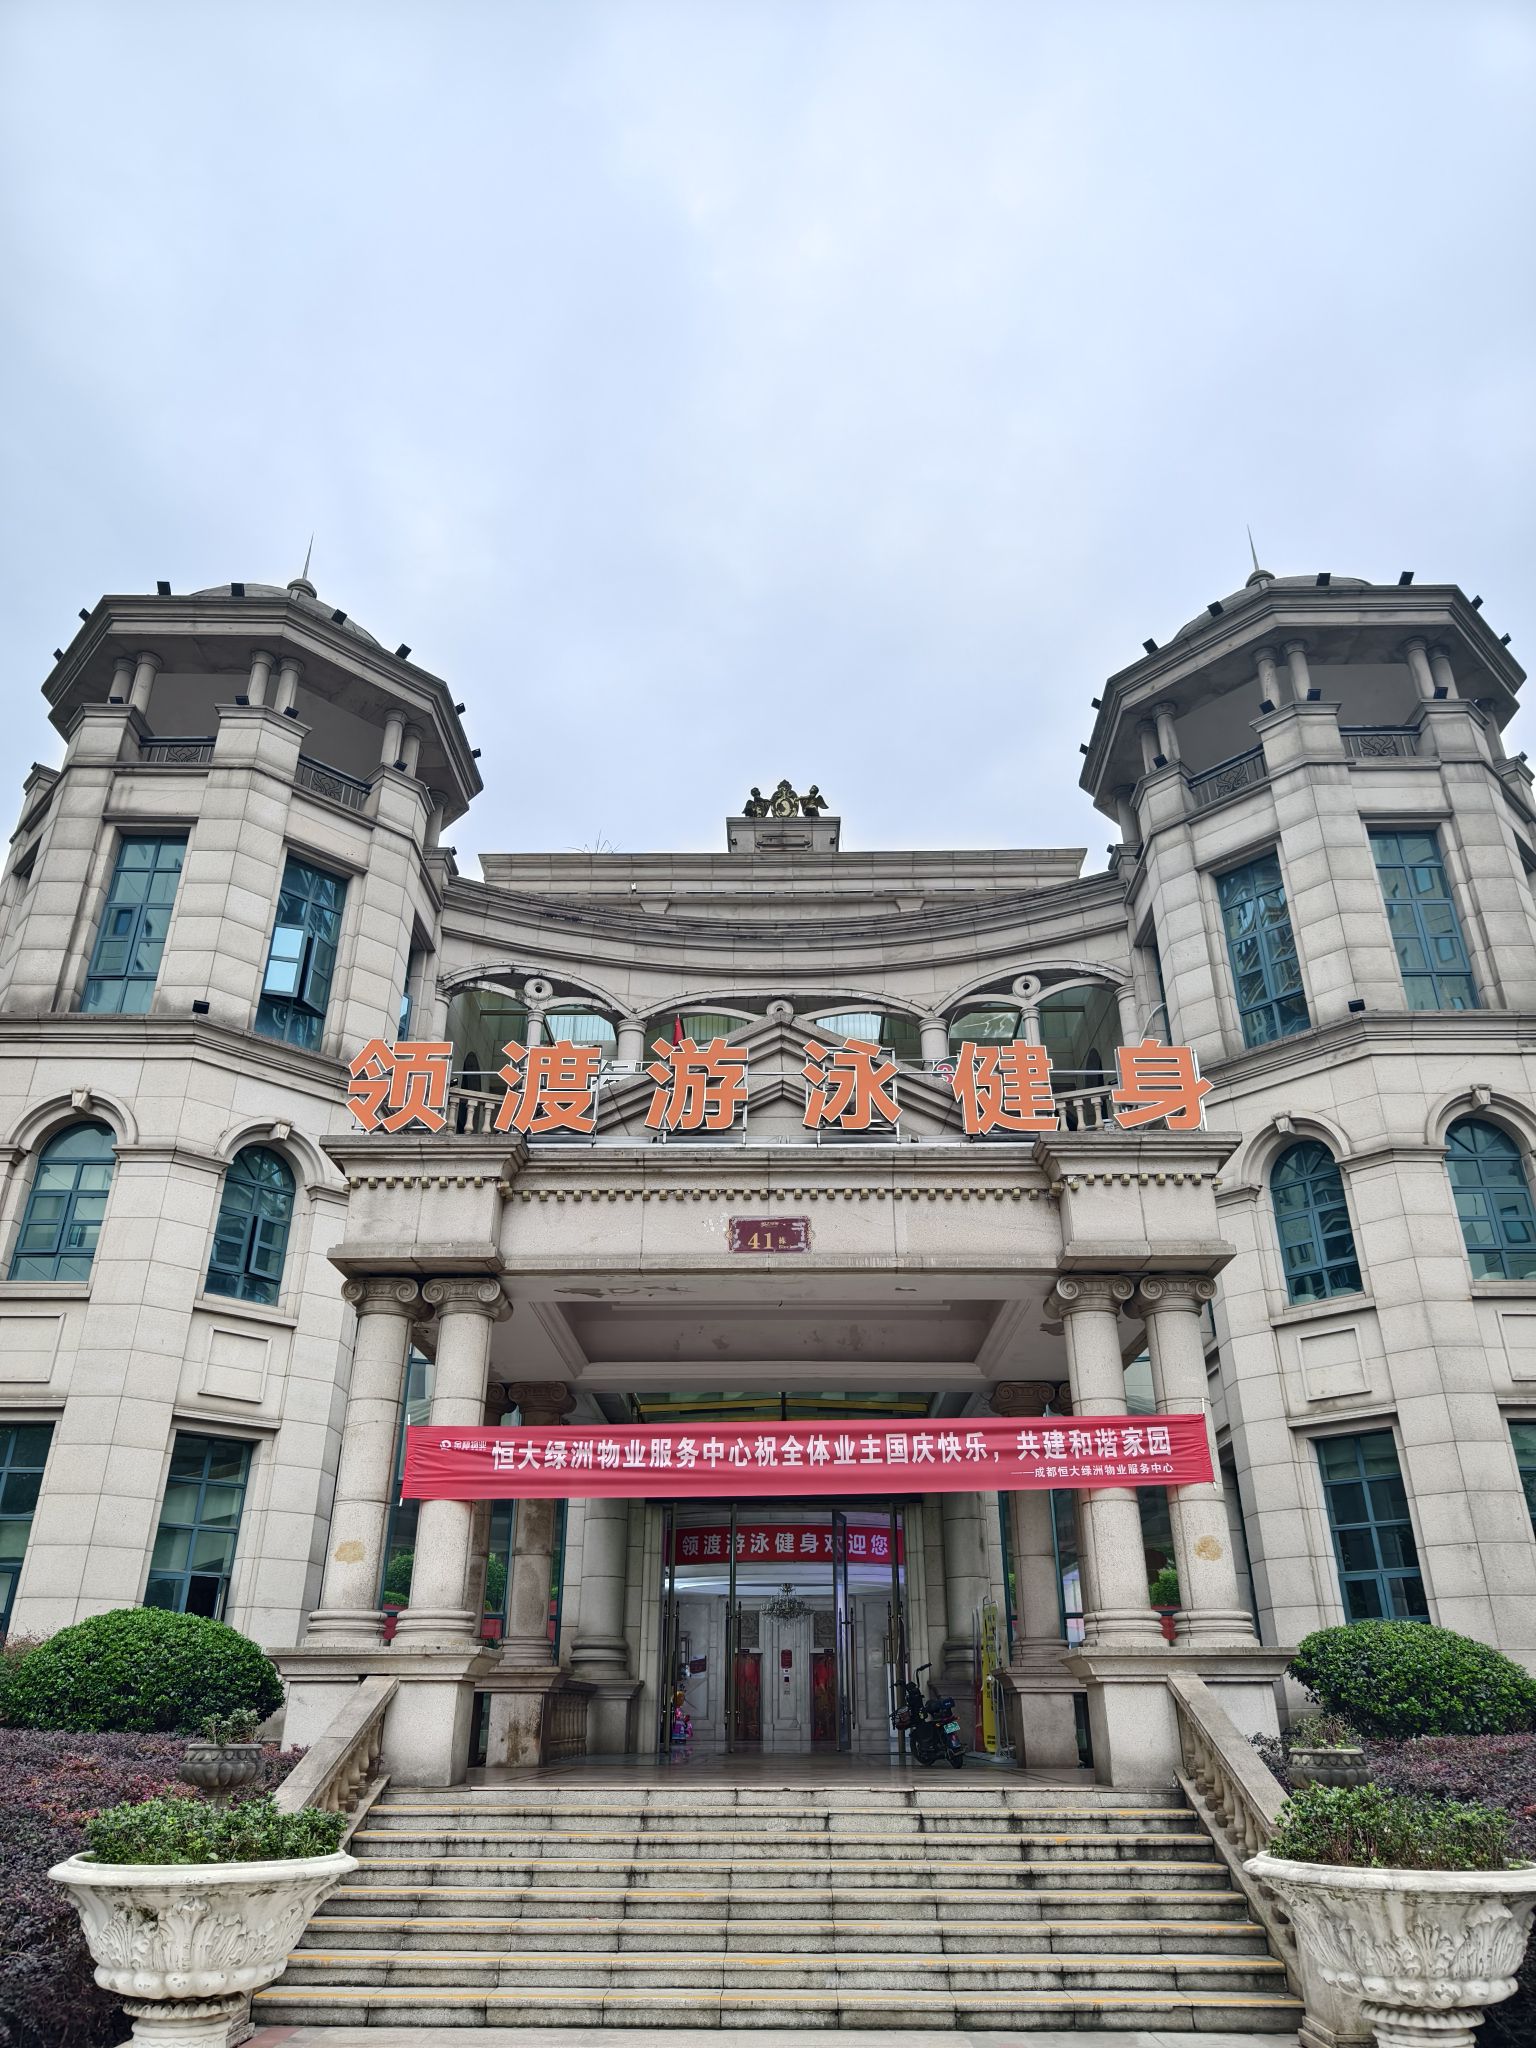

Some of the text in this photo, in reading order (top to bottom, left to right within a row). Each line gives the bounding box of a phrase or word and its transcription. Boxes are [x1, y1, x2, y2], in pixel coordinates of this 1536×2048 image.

[346, 1037, 1214, 1134] 领渡游泳健身
[682, 1532, 888, 1556] 领渡游泳健身欢迎您
